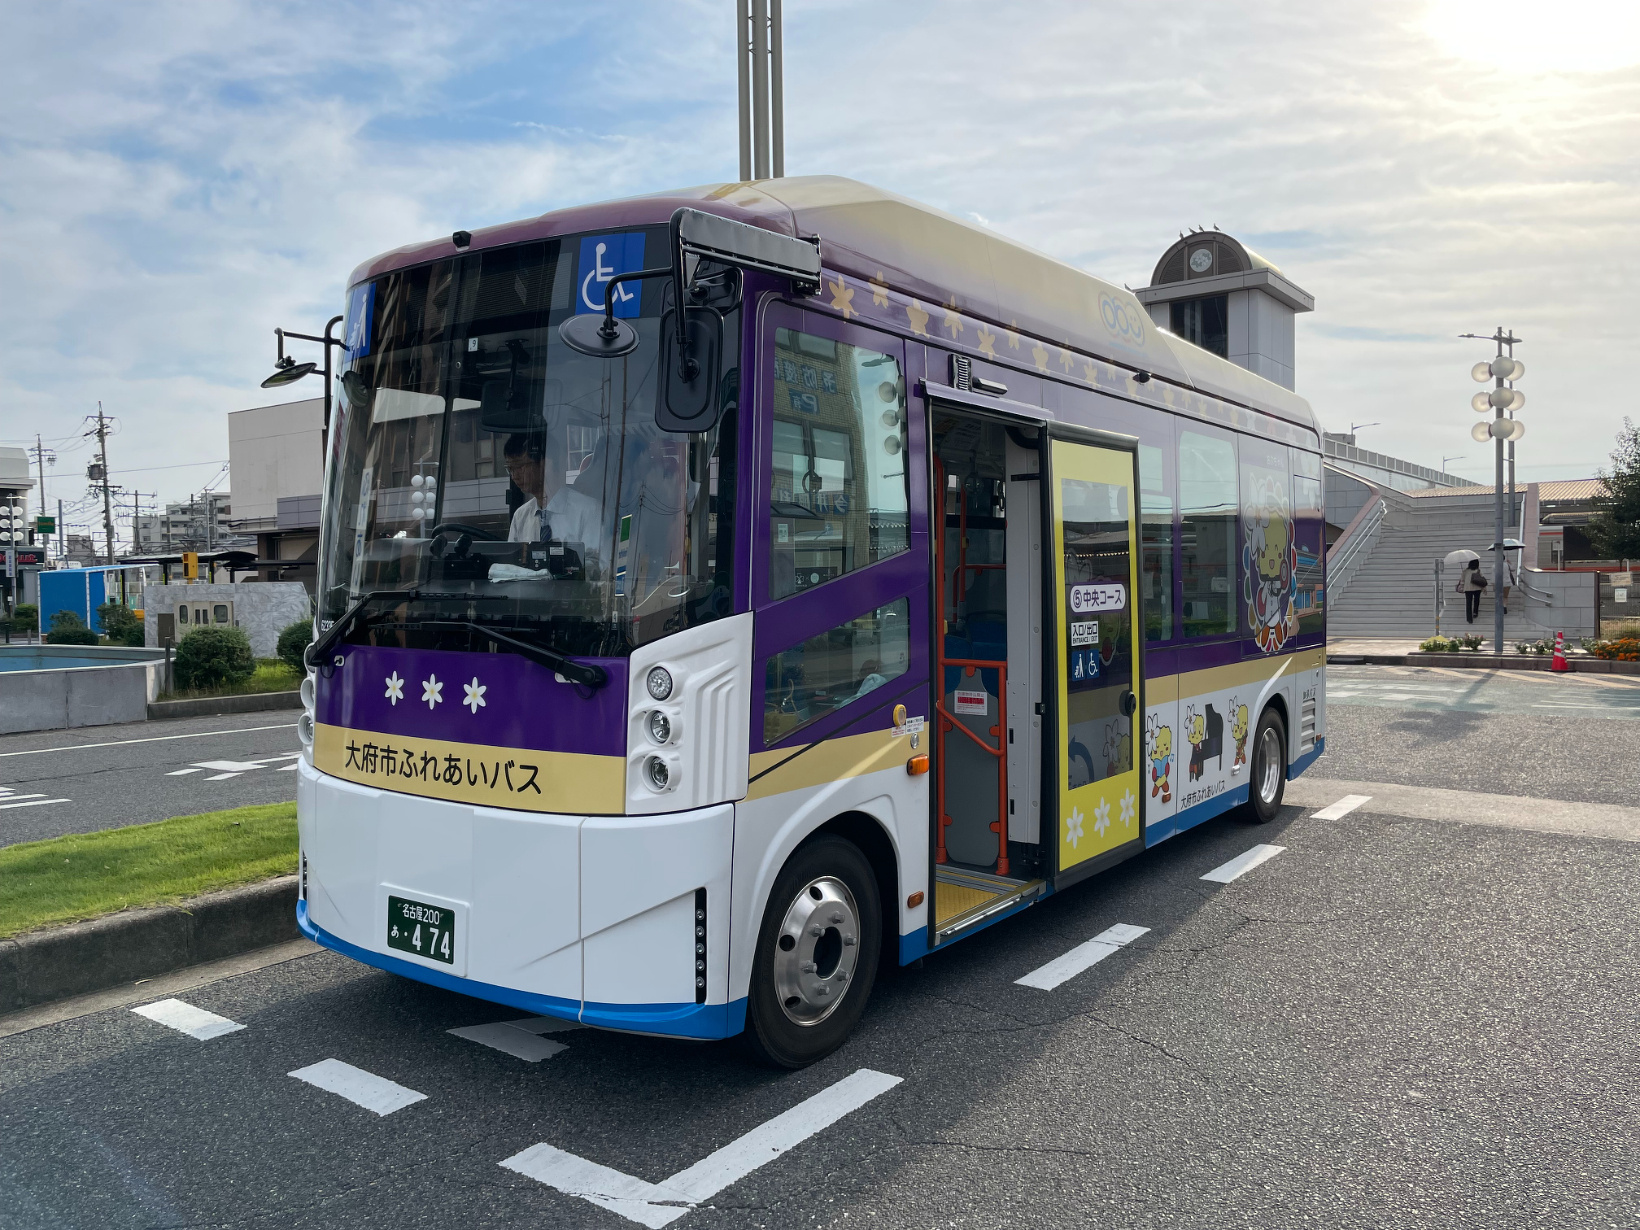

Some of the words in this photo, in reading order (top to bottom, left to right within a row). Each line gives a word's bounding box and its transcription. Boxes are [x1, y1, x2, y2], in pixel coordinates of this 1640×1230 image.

[345, 740, 542, 795] 大府市ふれあいバス
[1180, 780, 1226, 810] 大府市ふれあいバス
[390, 924, 400, 939] あ
